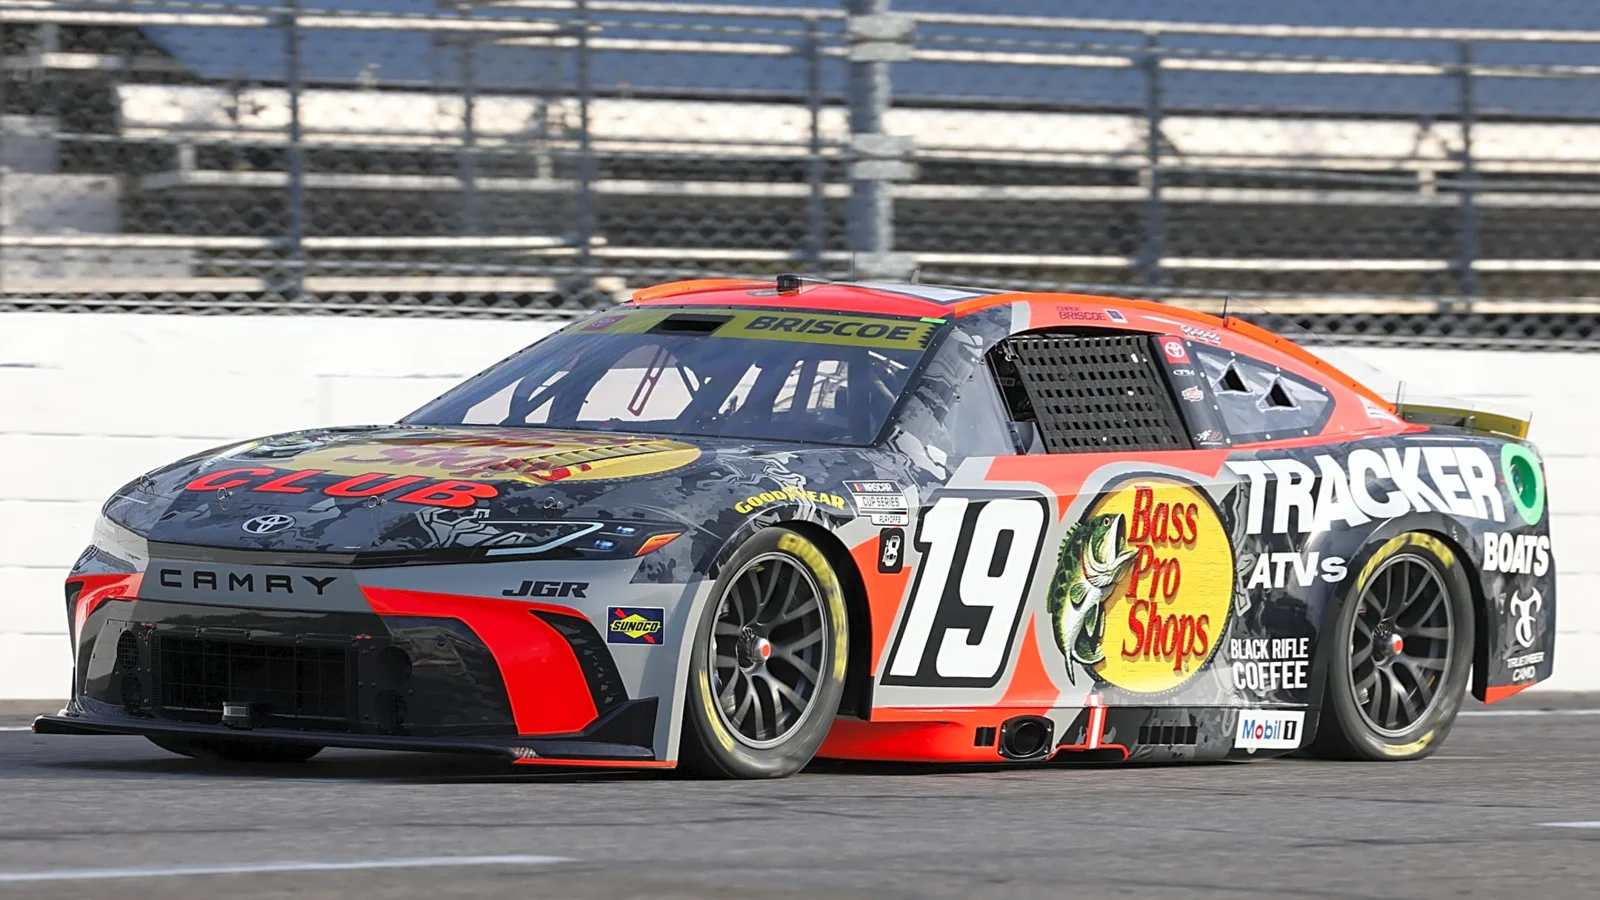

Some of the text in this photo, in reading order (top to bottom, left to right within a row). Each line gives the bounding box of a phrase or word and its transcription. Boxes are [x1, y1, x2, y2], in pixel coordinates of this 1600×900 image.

[745, 316, 916, 341] BRISCOE
[1058, 311, 1106, 321] BRISCOE
[185, 468, 498, 508] CLUB
[734, 486, 845, 514] GOODYEAR
[864, 483, 893, 492] NASCAR
[1225, 447, 1505, 535] TRACKER
[862, 497, 900, 508] CUP SERIES
[1128, 486, 1198, 544] Bass
[879, 515, 901, 524] PLAYOFFS
[1483, 532, 1550, 577] BOATS
[160, 568, 338, 596] CAMRY
[1126, 545, 1181, 599] Pro
[1247, 551, 1348, 589] ATVs
[502, 580, 590, 598] JGR
[889, 497, 1045, 679] 19
[612, 621, 660, 632] SUNOCO
[1121, 600, 1210, 671] Shops
[1230, 637, 1309, 660] BLACK RIFLE
[1232, 660, 1309, 690] COFFEE
[1512, 665, 1536, 682] CAMO
[1242, 719, 1281, 740] Mobil
